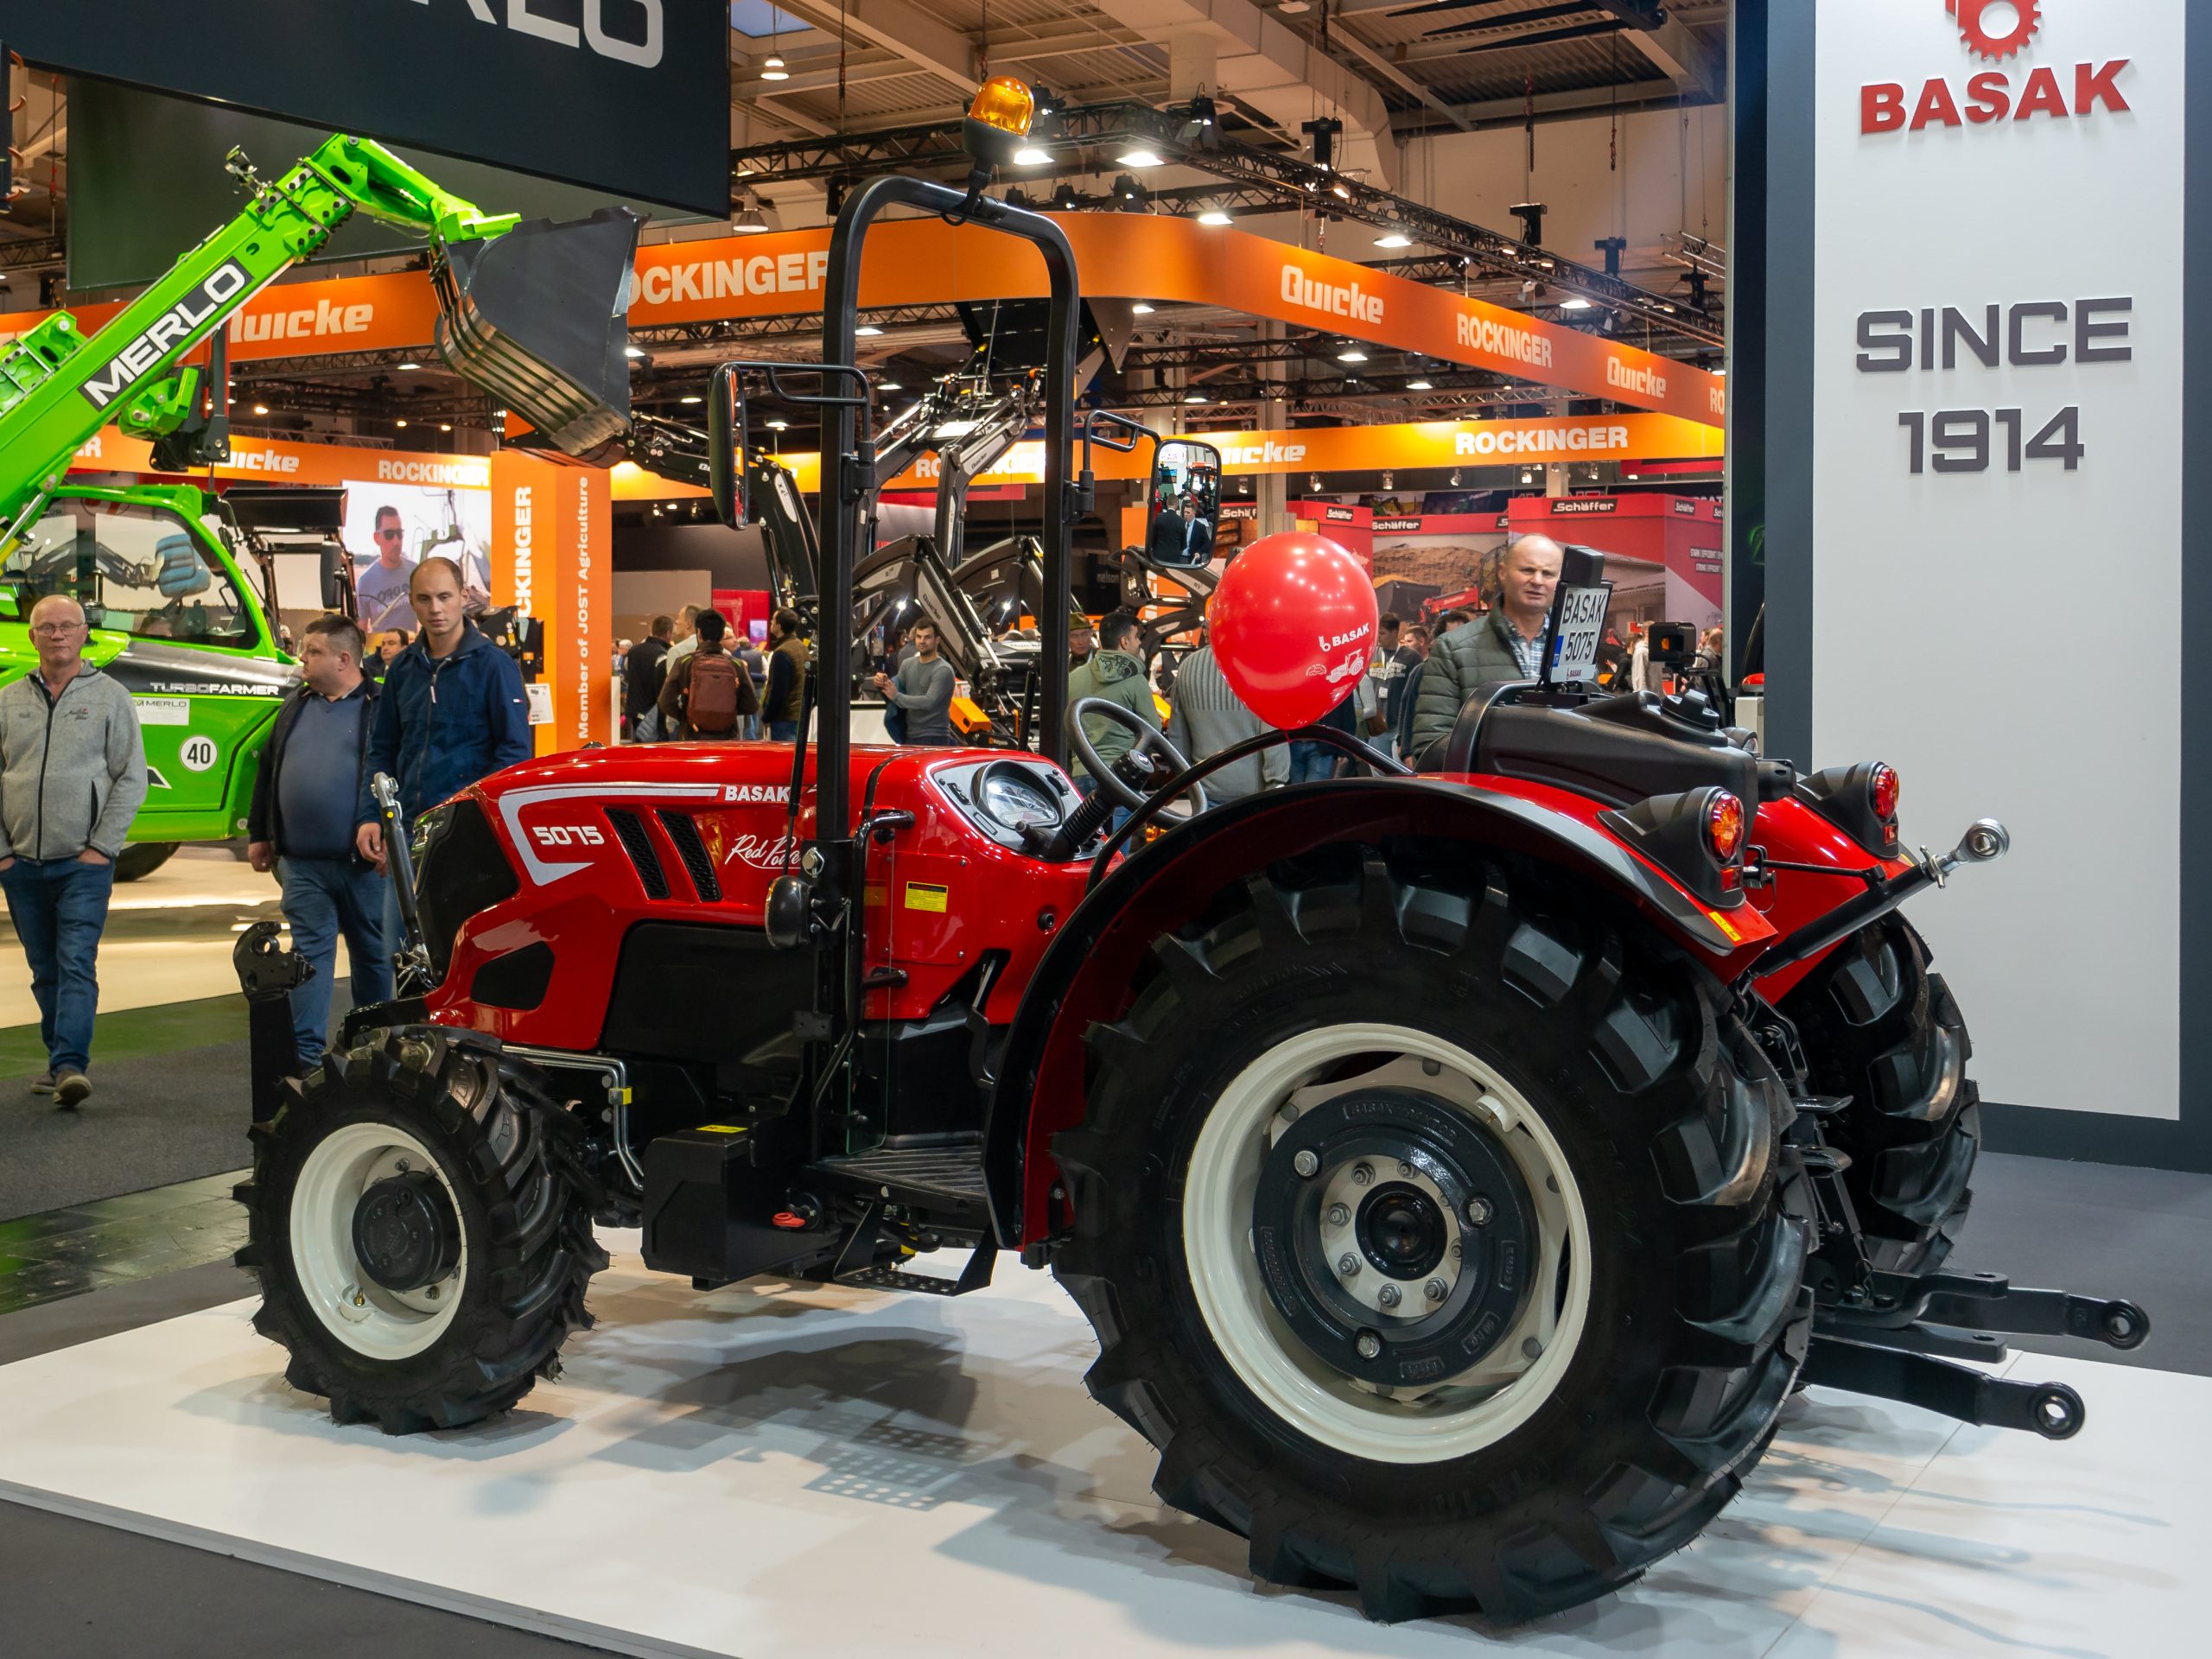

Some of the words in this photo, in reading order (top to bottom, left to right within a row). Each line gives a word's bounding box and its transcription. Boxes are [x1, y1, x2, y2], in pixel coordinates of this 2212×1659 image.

[1861, 59, 2131, 136] BASAK
[628, 251, 830, 307] CKINGER
[1281, 264, 1384, 325] Quicke
[84, 264, 246, 407] MERLO
[1457, 313, 1553, 368] ROCKINGER
[1856, 297, 2133, 372] SINCE
[1606, 355, 1667, 398] Quicke
[1455, 426, 1629, 456] ROCKINGER
[1898, 406, 2085, 474] 1914
[378, 460, 489, 486] ROCKINGER
[1219, 508, 1257, 518] Schäf
[1553, 501, 1614, 512] Schäffer
[577, 476, 591, 581] Agriculture
[1372, 520, 1420, 531] Schäffer
[515, 486, 532, 619] CKINGER
[577, 585, 589, 634] JOST
[1561, 593, 1606, 624] BASAK
[577, 638, 589, 658] of
[1332, 622, 1370, 647] BASAK
[1565, 632, 1596, 661] 5075
[150, 682, 279, 695] TURBOFARMER
[577, 663, 589, 739] Member
[187, 743, 211, 765] 40
[725, 785, 791, 802] BASAK
[532, 826, 605, 846] 5075
[724, 834, 769, 866] Red
